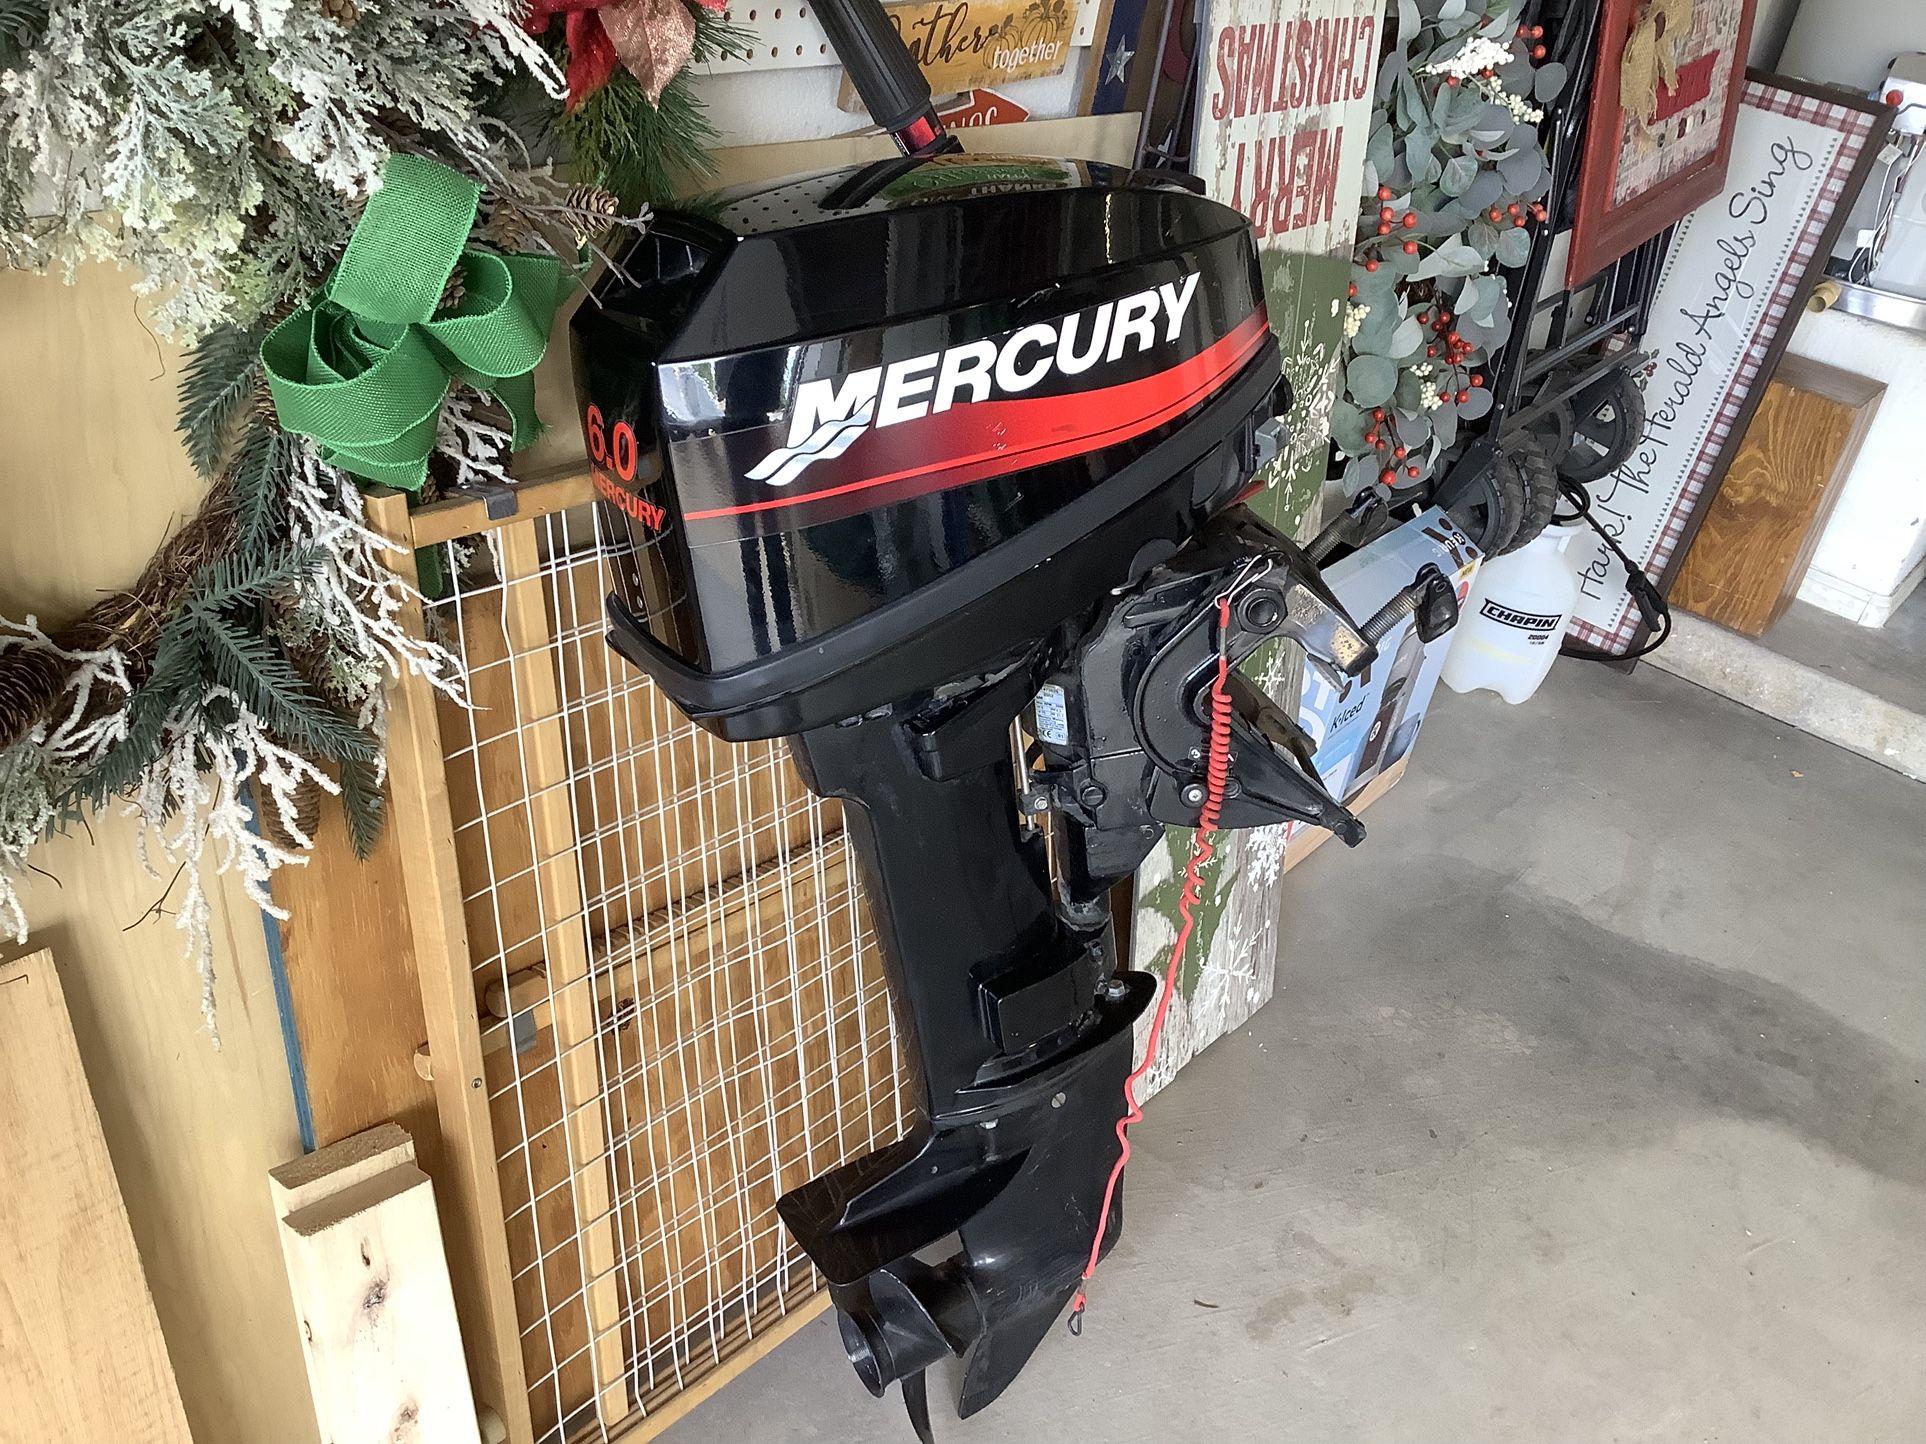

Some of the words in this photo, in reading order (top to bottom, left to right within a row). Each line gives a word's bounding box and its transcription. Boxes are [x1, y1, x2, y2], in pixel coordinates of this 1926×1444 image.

[889, 2, 996, 67] ather
[992, 36, 1063, 72] together
[1211, 15, 1375, 121] CHRISTMAS
[1231, 126, 1344, 240] MERRY
[1596, 447, 1658, 504] The
[1639, 341, 1706, 447] Herald
[1680, 229, 1756, 340] Angels
[1728, 135, 1813, 224] Sing
[786, 272, 1201, 449] MERCURY
[587, 402, 638, 483] 6.0
[590, 462, 666, 532] MERCURY
[1486, 606, 1556, 628] CHAPIN
